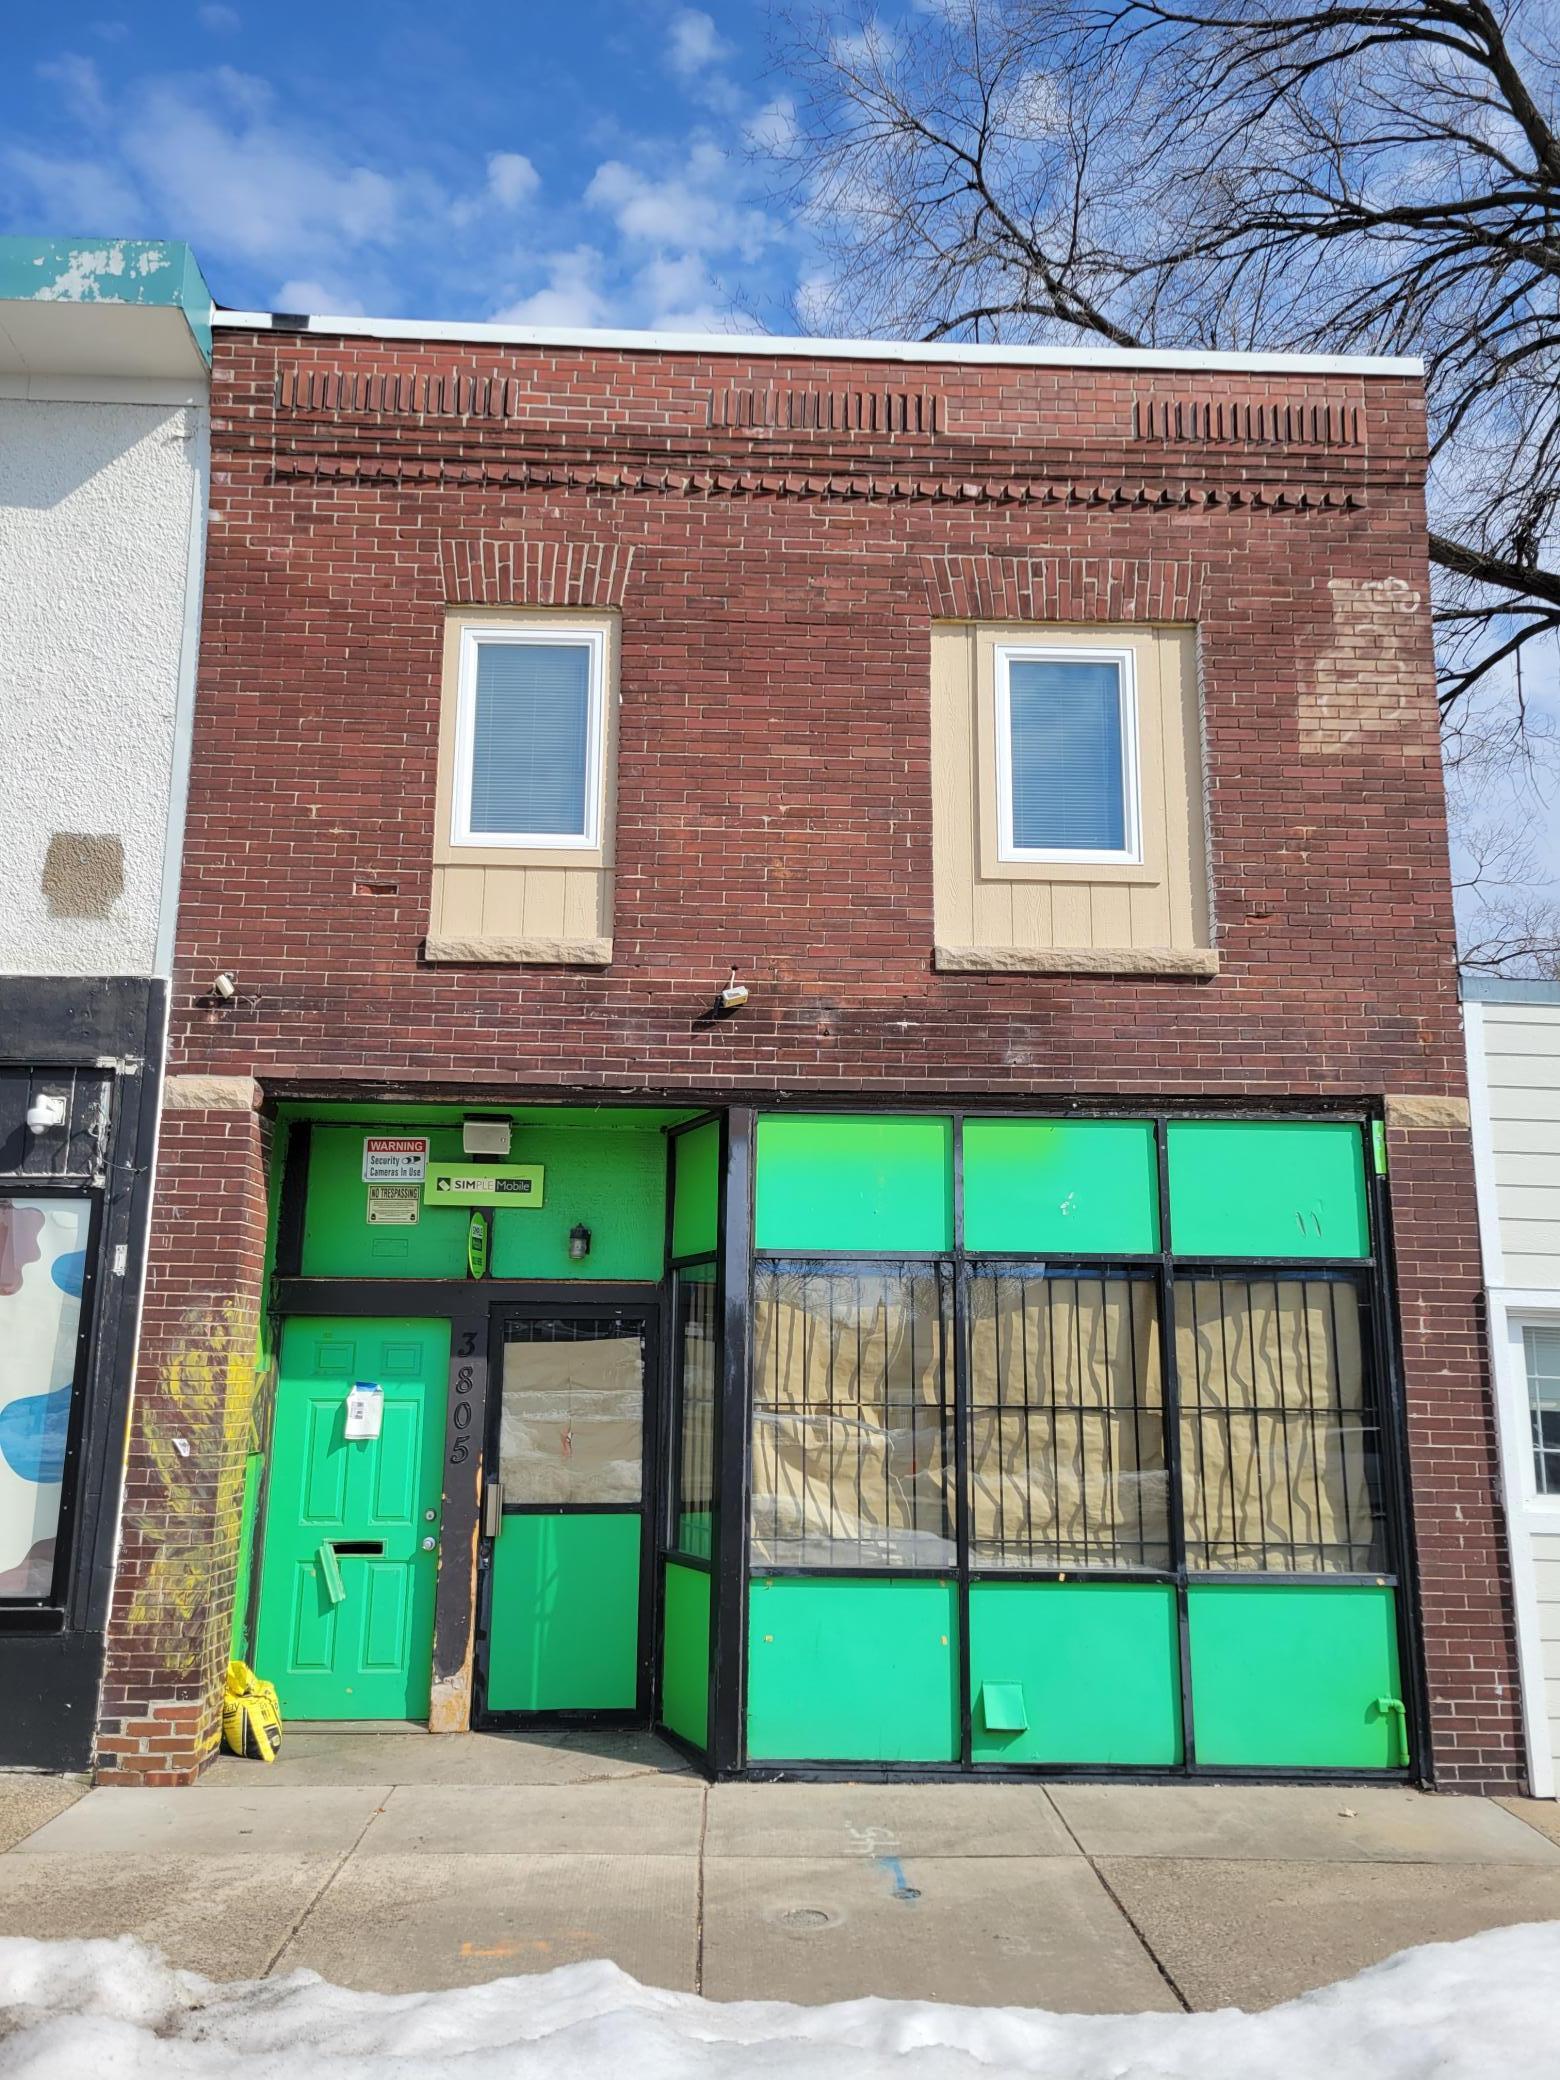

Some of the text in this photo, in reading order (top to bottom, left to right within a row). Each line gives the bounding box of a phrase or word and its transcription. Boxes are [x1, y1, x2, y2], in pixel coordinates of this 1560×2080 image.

[371, 1141, 423, 1151] WARNING
[370, 1155, 399, 1166] Security
[370, 1167, 399, 1176] Cameras
[409, 1168, 421, 1176] Use
[371, 1188, 418, 1199] NO TRESPASSING
[450, 1332, 478, 1464] 3805
